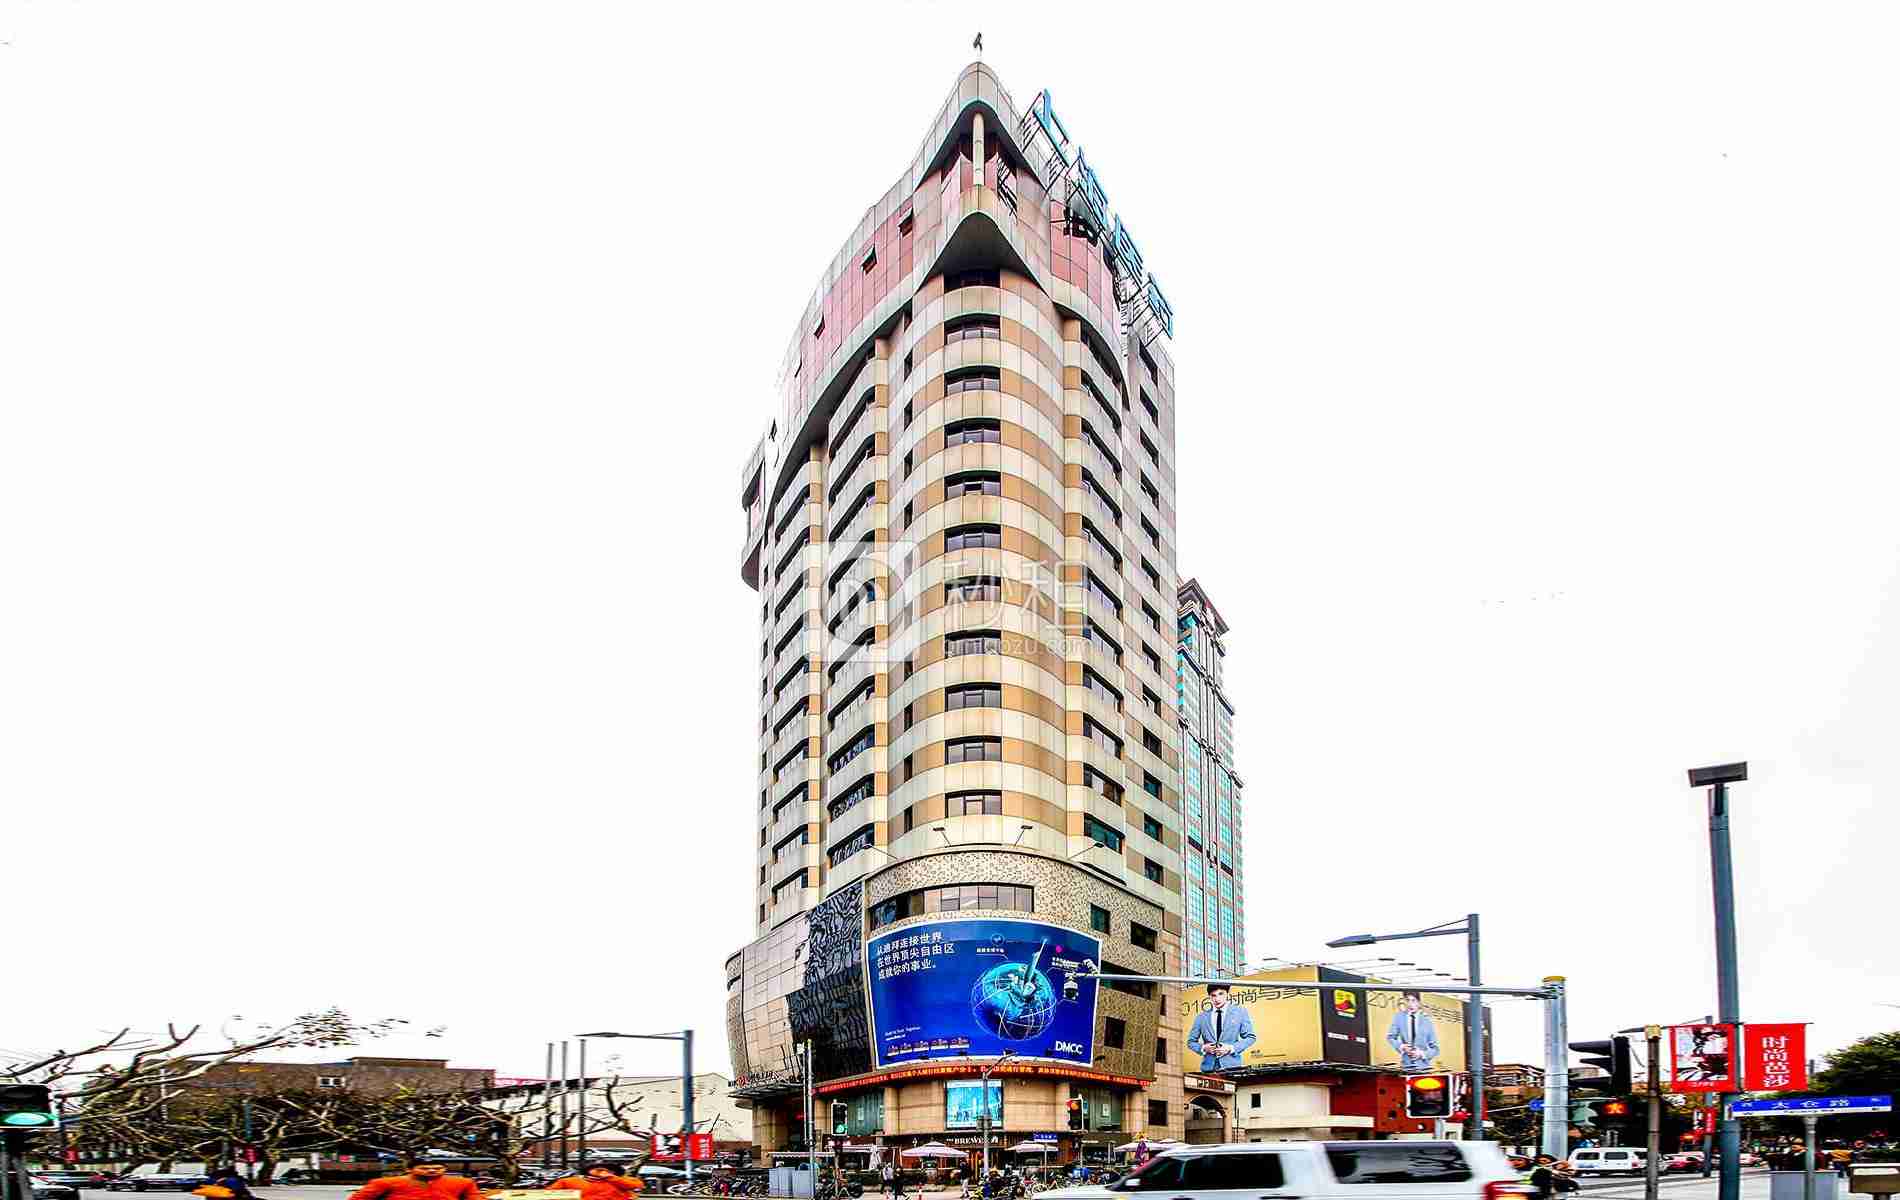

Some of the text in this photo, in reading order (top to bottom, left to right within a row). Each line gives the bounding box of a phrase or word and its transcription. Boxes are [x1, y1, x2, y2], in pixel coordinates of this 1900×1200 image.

[877, 931, 942, 955] 从迪拜连接世界
[877, 943, 955, 968] 在世界顶尖自由区
[1055, 1040, 1083, 1055] DMCC
[1762, 1035, 1791, 1088] 时尚芭莎
